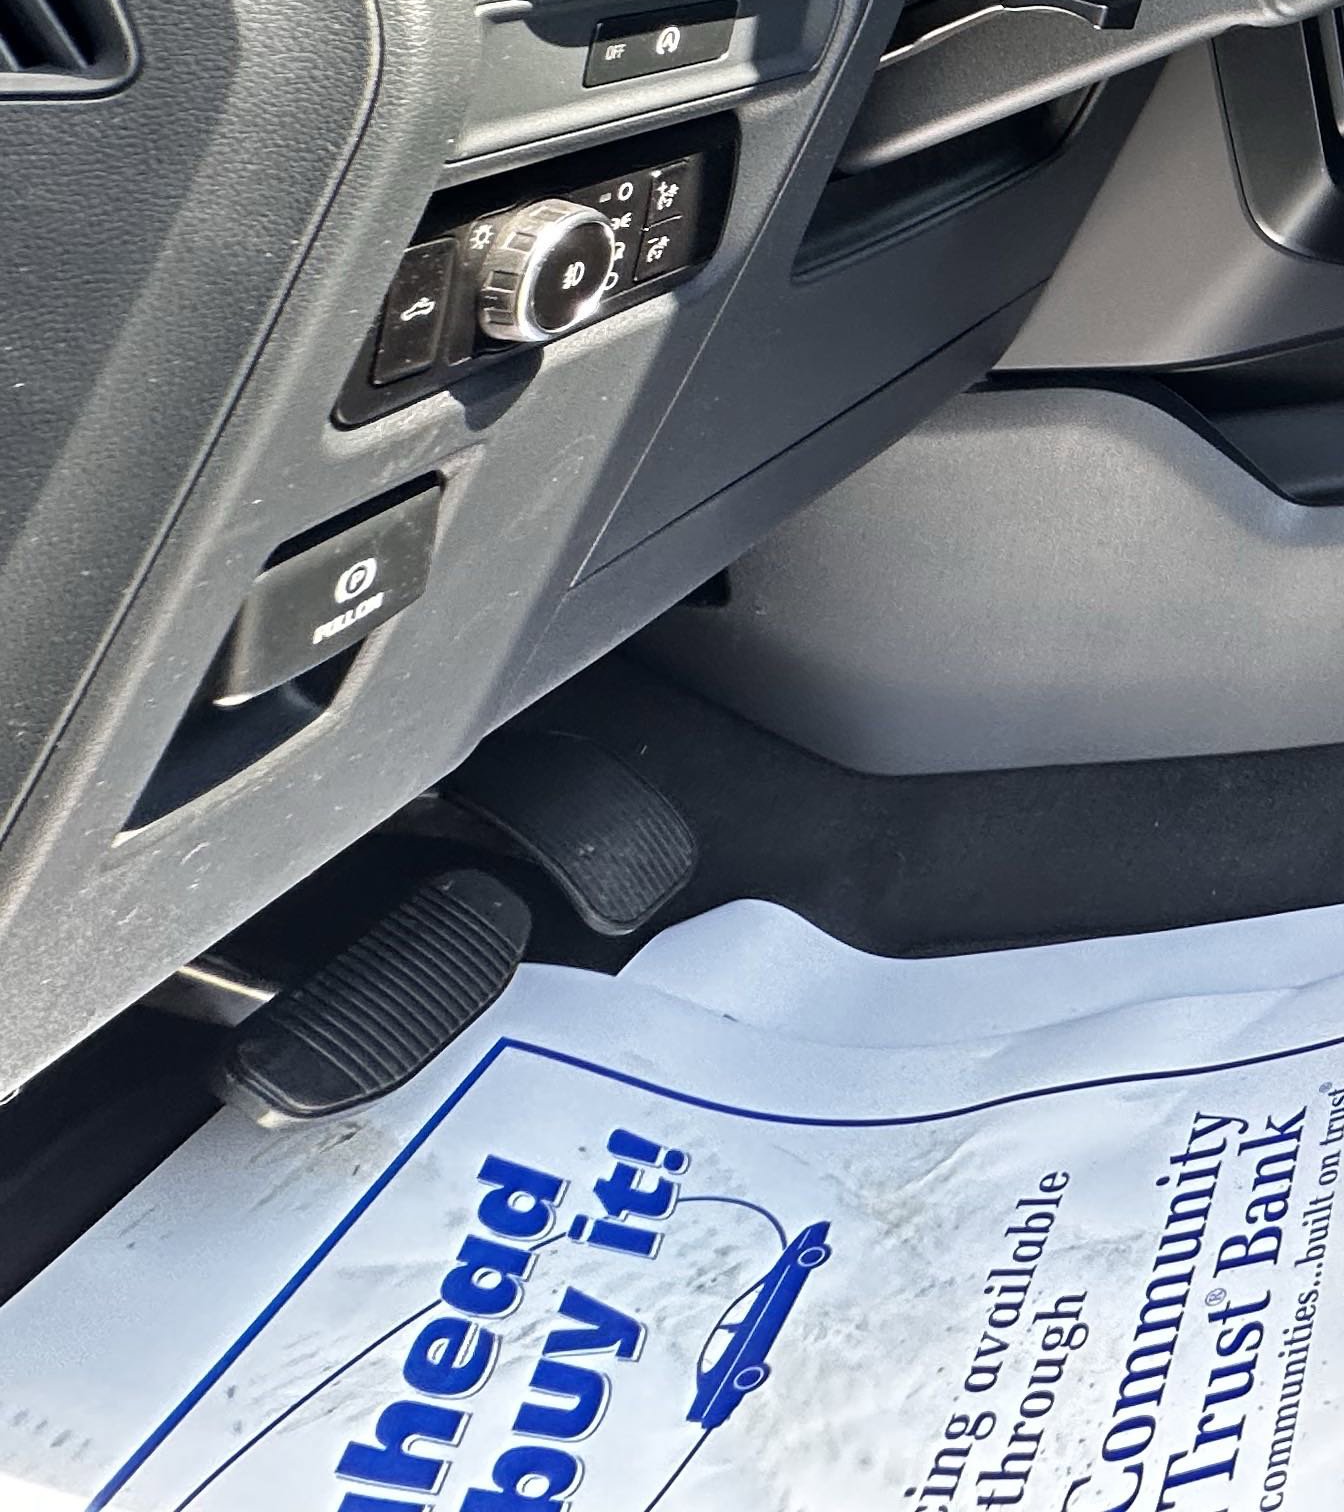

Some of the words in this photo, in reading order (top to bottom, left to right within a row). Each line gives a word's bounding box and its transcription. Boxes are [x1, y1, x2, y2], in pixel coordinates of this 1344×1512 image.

[604, 43, 627, 61] OFF
[1211, 1104, 1308, 1280] Bank
[1319, 1144, 1343, 1189] on
[335, 1152, 570, 1512] head
[458, 1286, 648, 1512] buy
[567, 1127, 693, 1261] it!
[963, 1169, 1071, 1394] available
[1058, 1109, 1249, 1512] Community
[974, 1288, 1090, 1512] through
